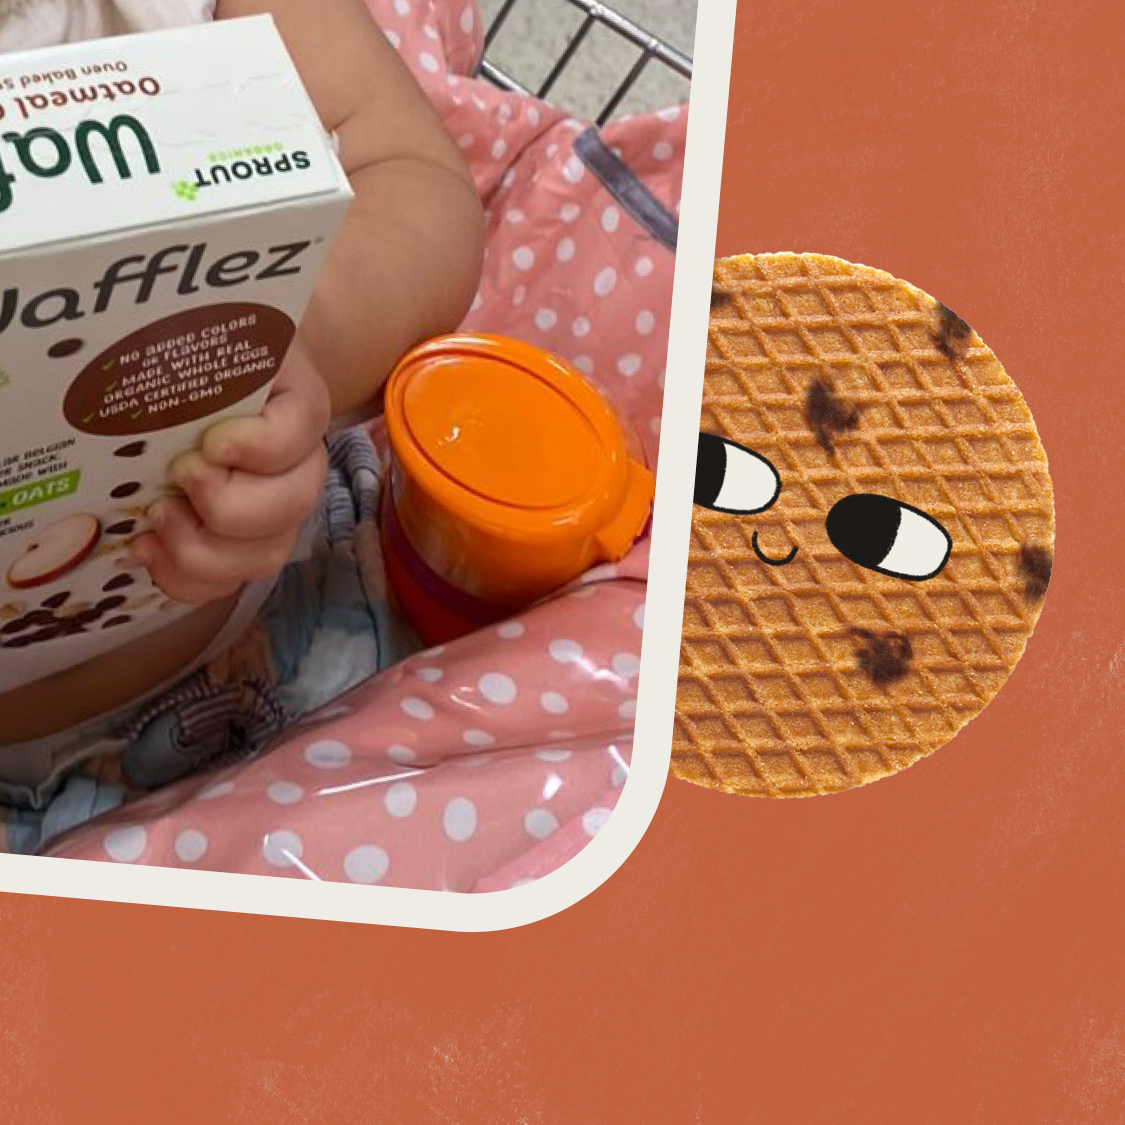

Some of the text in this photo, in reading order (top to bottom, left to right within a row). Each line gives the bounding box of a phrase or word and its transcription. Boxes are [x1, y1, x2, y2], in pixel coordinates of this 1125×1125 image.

[20, 68, 78, 89] Baked
[81, 60, 128, 76] Oven
[21, 76, 160, 119] Oatmeal
[195, 150, 311, 188] SPROUT
[119, 350, 140, 366] NO
[200, 313, 257, 338] COLORS
[171, 352, 210, 371] WITH
[217, 340, 251, 357] REAL
[99, 357, 275, 418] USDA CERTIFIED ORGANIC
[103, 374, 171, 404] ORGANIC
[178, 358, 228, 380] WHOLE
[147, 385, 223, 414] NON-GMO
[13, 478, 70, 505] OATS
